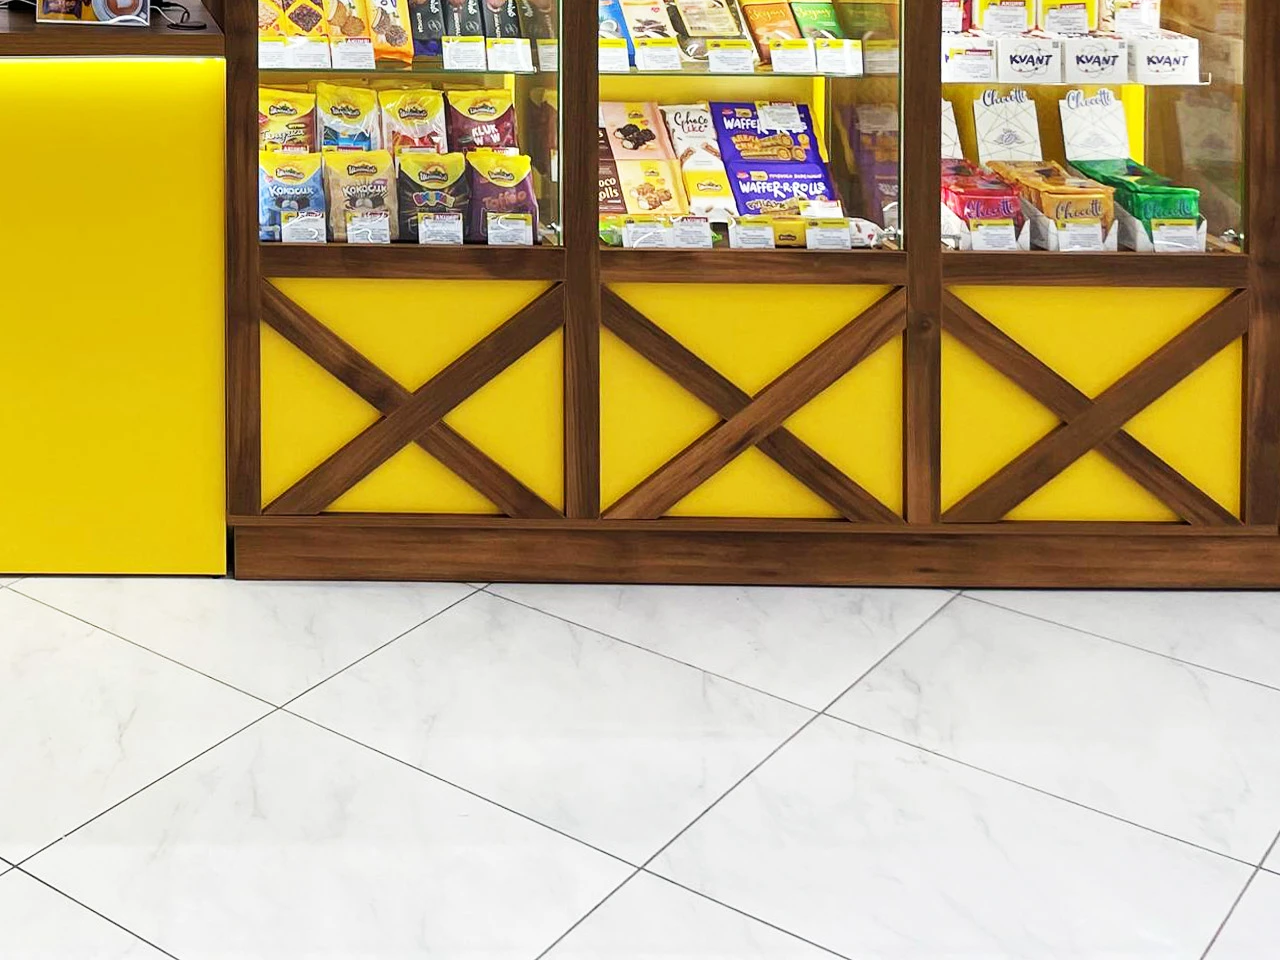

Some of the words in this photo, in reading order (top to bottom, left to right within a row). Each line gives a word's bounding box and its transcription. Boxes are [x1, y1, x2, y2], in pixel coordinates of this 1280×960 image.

[1009, 54, 1053, 67] KVANT
[1075, 54, 1120, 67] KVANT
[1146, 55, 1189, 67] KVANT
[472, 124, 499, 138] KLUK
